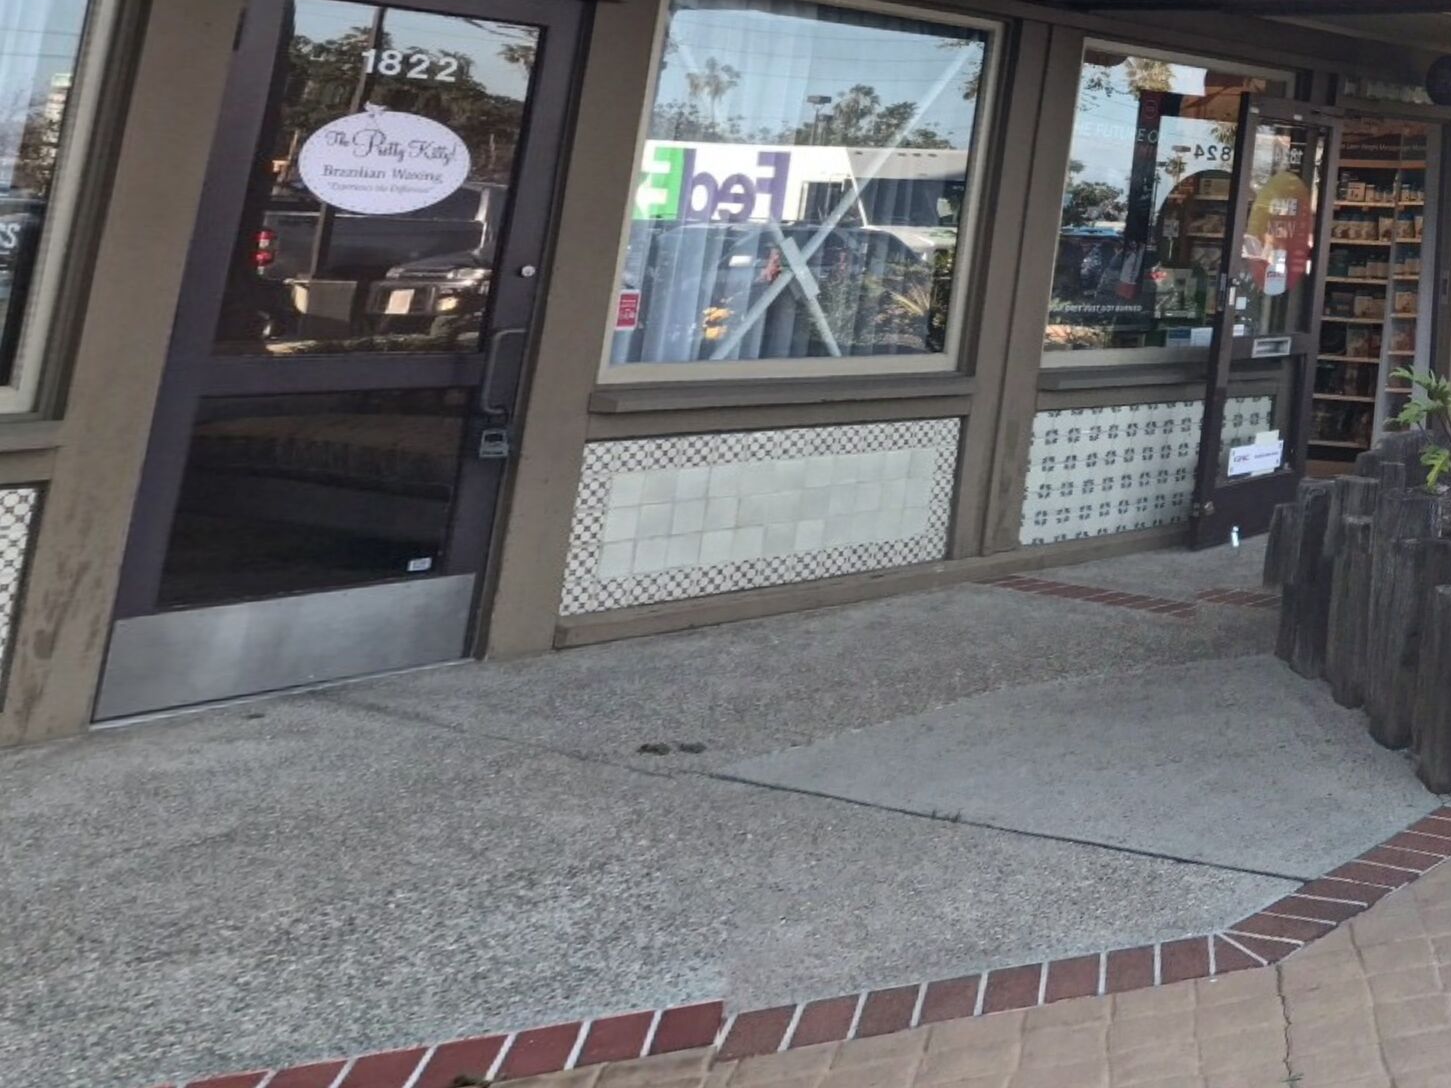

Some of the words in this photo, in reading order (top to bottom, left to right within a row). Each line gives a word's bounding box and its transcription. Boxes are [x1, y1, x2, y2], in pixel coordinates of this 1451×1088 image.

[361, 47, 457, 83] 1822
[322, 164, 386, 180] Brazilian
[392, 167, 444, 184] Waxing
